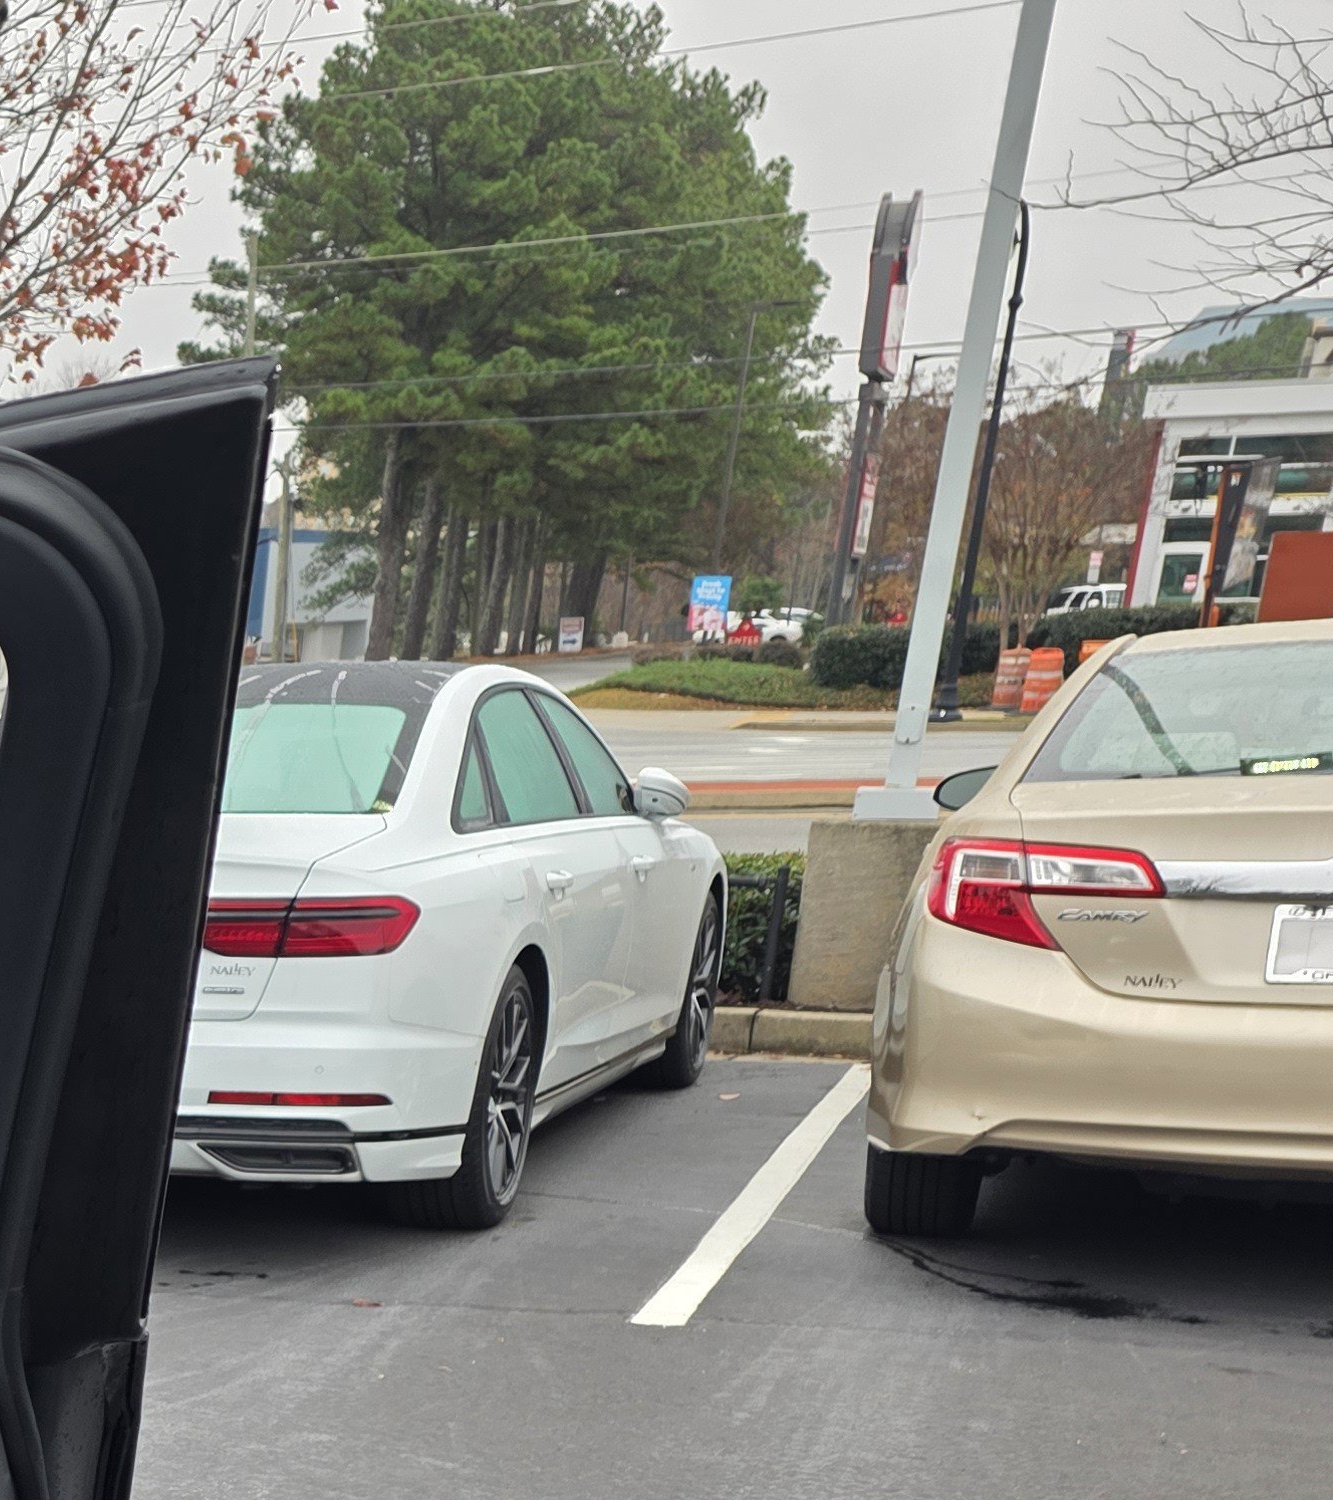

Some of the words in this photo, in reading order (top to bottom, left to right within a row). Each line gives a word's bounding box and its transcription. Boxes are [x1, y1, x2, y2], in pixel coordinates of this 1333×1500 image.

[728, 635, 760, 646] ENTER
[1058, 908, 1150, 924] CAMRY
[210, 962, 256, 976] NALLEY
[1124, 973, 1183, 989] NALLEY
